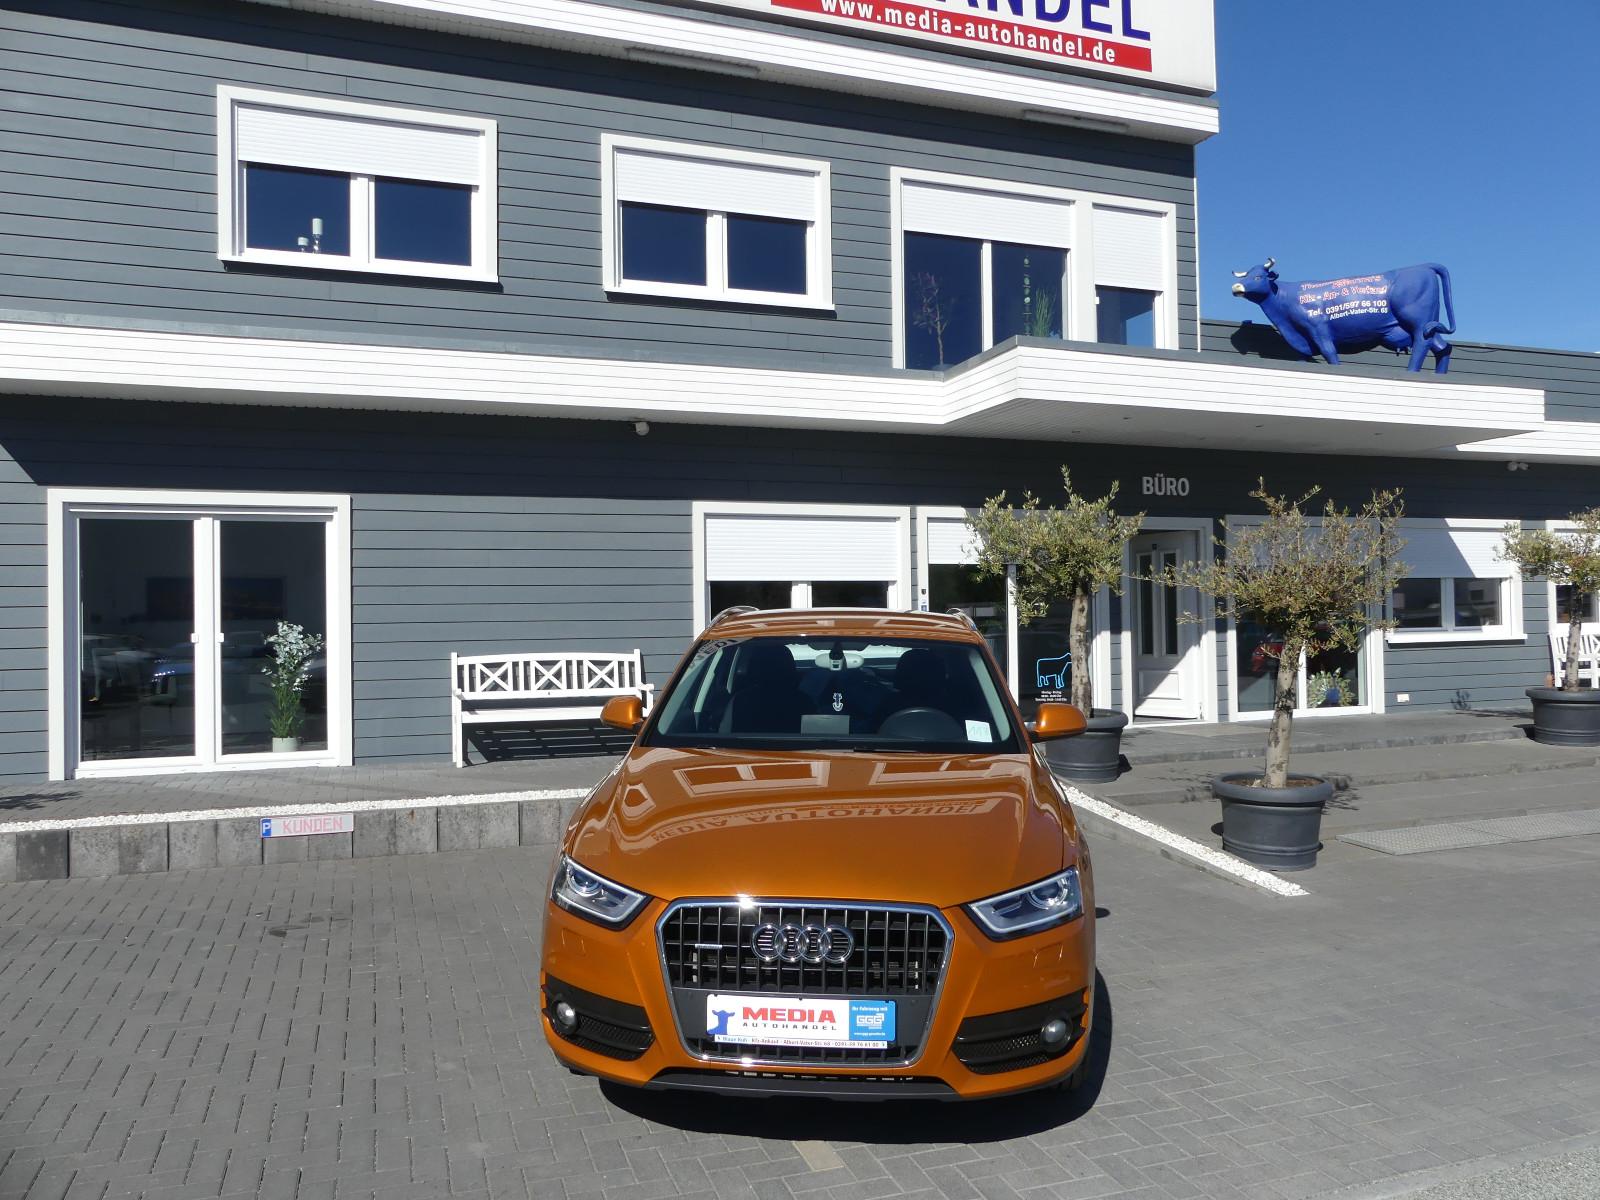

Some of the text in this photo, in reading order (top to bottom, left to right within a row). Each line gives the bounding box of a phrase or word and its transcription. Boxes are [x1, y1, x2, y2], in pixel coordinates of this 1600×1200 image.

[820, 0, 1116, 63] www.media-autohandel.de
[1326, 301, 1359, 313] 0391/597
[1373, 299, 1387, 307] 100
[1142, 473, 1190, 496] BÜRO
[262, 816, 343, 834] P KUNDEN
[742, 1007, 836, 1023] MEDIA
[742, 1022, 837, 1031] AUTOHANDEL
